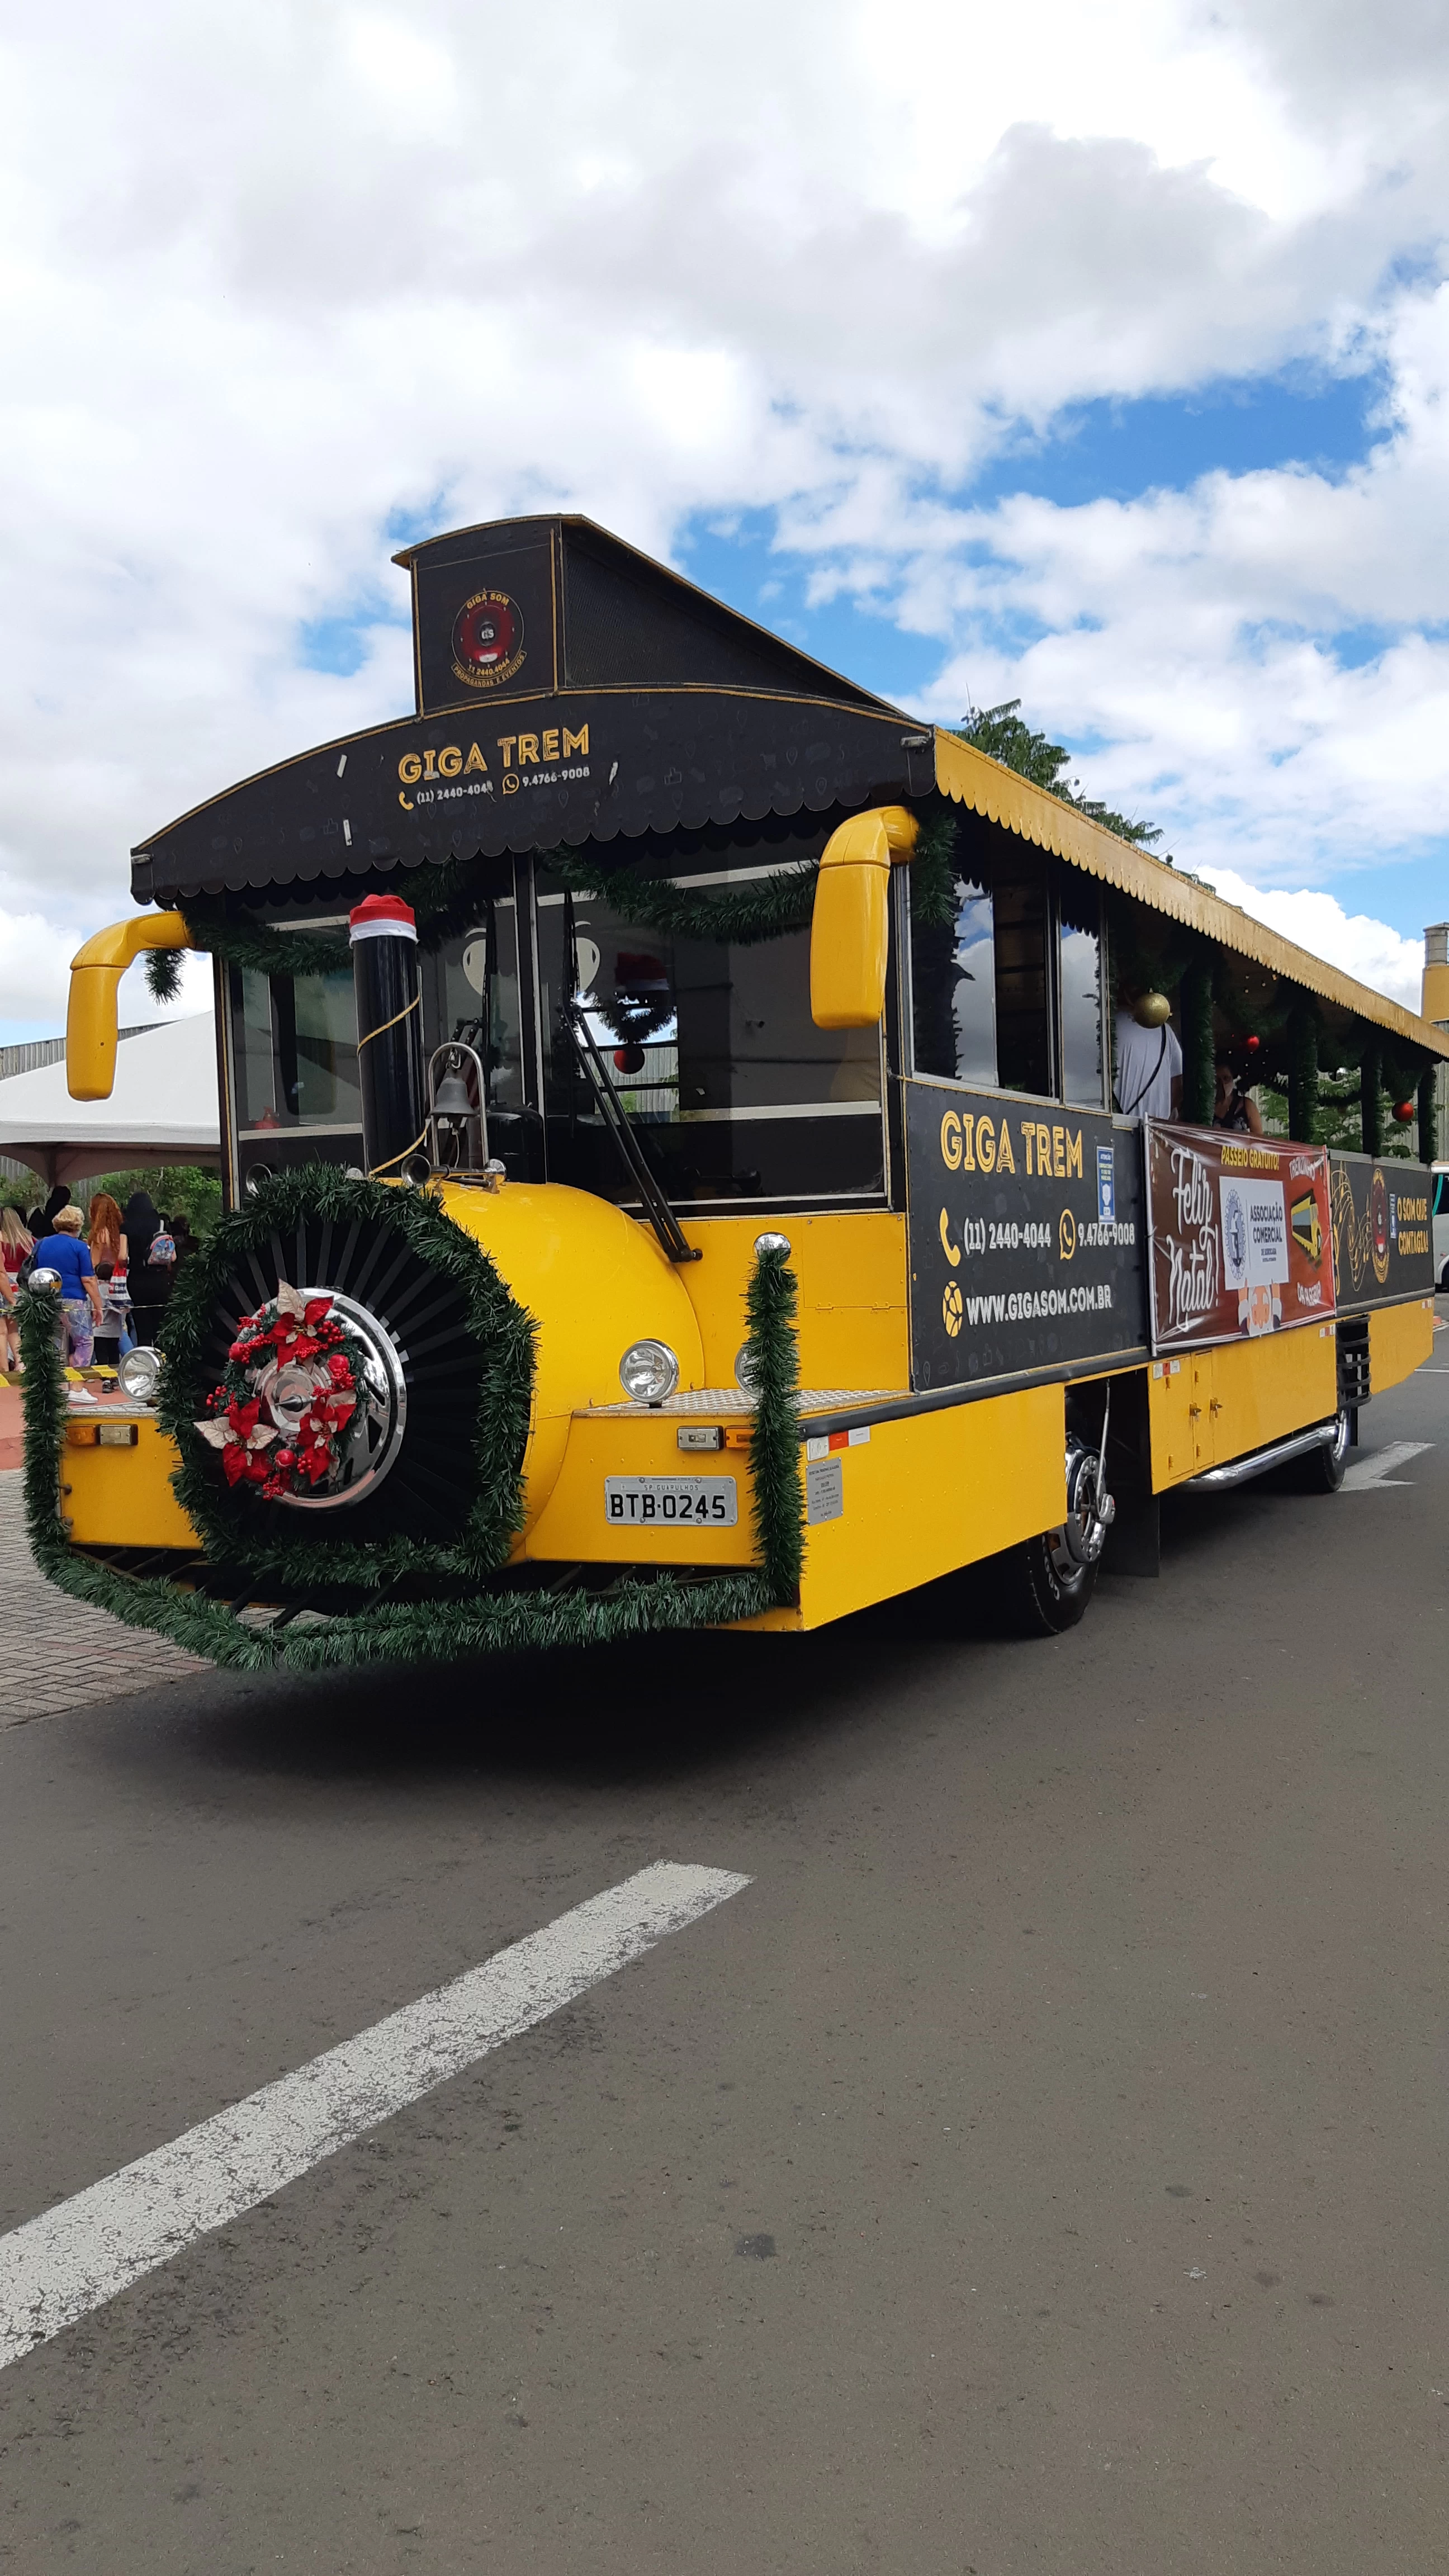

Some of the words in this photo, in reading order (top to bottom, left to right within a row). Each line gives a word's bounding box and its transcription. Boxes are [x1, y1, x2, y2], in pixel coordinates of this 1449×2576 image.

[466, 594, 487, 609] GIGA
[490, 593, 510, 606] SOM
[481, 629, 494, 640] GS
[454, 666, 494, 687] PROPAGANDAS
[501, 654, 525, 680] EVENTOS
[398, 742, 487, 784] GIGA
[498, 723, 589, 768] TREM
[522, 766, 590, 787] 9.4766-9008
[417, 790, 434, 805] (11)
[437, 780, 494, 801] 2440-404
[940, 1110, 1016, 1174] GIGA
[1021, 1121, 1083, 1178] TREM
[1221, 1145, 1248, 1168] PASSEIO
[1249, 1148, 1280, 1171] GRATUITO!
[1171, 1147, 1216, 1251] Feliz
[1397, 1197, 1402, 1221] O
[1403, 1197, 1415, 1221] SOM
[1416, 1197, 1428, 1221] QUE
[1250, 1201, 1283, 1225] ASSOCIAÇÃO
[964, 1217, 986, 1256] (11)
[988, 1223, 1052, 1250] 2440-4044
[1078, 1222, 1135, 1247] 9.4766-9008
[1253, 1227, 1283, 1244] COMERCIAL
[1398, 1230, 1429, 1256] CONTAGIA!
[966, 1285, 1112, 1326] WWW.GIGASOM.COM.BR
